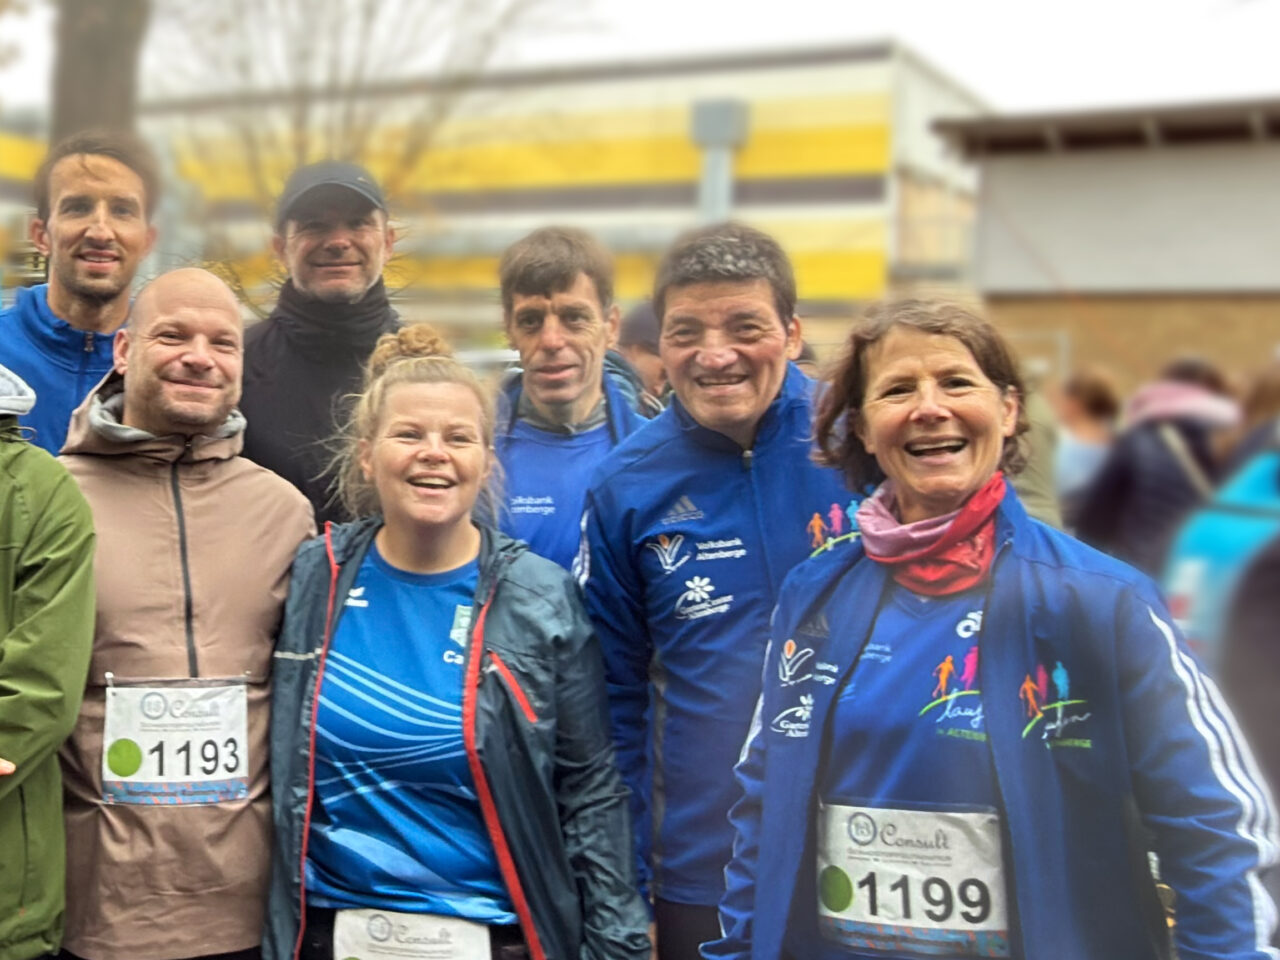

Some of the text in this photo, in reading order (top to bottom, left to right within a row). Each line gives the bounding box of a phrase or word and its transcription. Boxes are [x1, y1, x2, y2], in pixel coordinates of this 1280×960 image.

[148, 737, 240, 777] 1193
[880, 823, 950, 849] Consult
[857, 871, 992, 924] 1199
